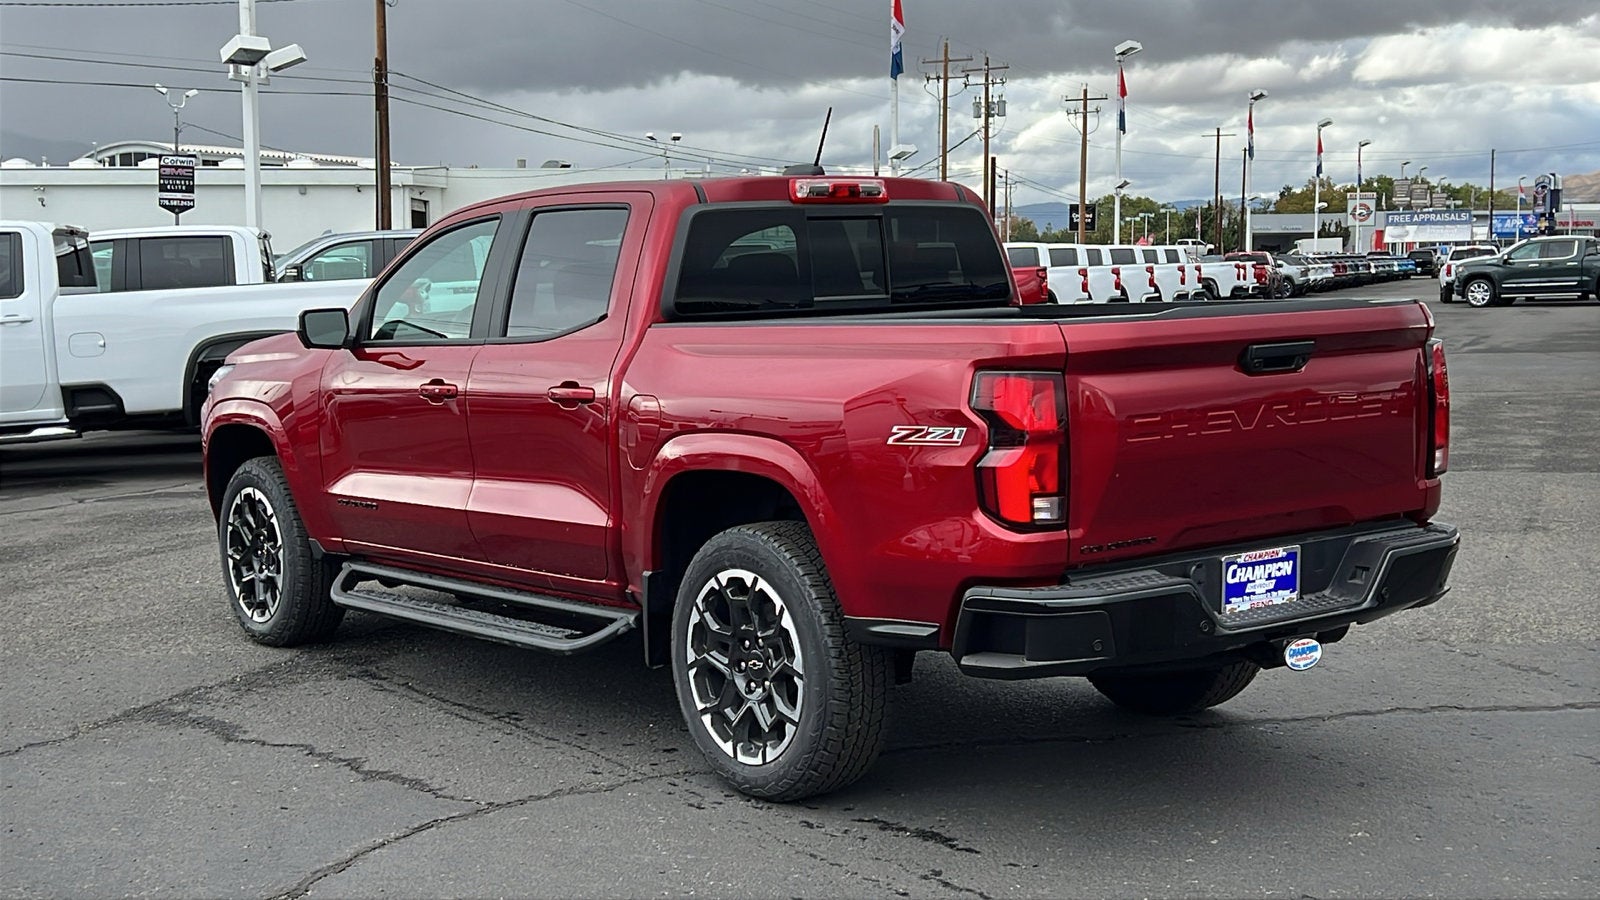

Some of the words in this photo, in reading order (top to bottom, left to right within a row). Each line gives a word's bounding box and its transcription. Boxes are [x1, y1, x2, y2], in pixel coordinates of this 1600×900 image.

[162, 157, 194, 165] Corwin
[160, 168, 193, 176] GMC
[1388, 214, 1411, 223] FREE
[1413, 212, 1469, 222] APPRAISALS!
[1126, 392, 1408, 442] CHEVROLET
[886, 425, 968, 446] Z71
[1244, 549, 1280, 562] CHAMPION
[1226, 560, 1293, 584] CHAMPION
